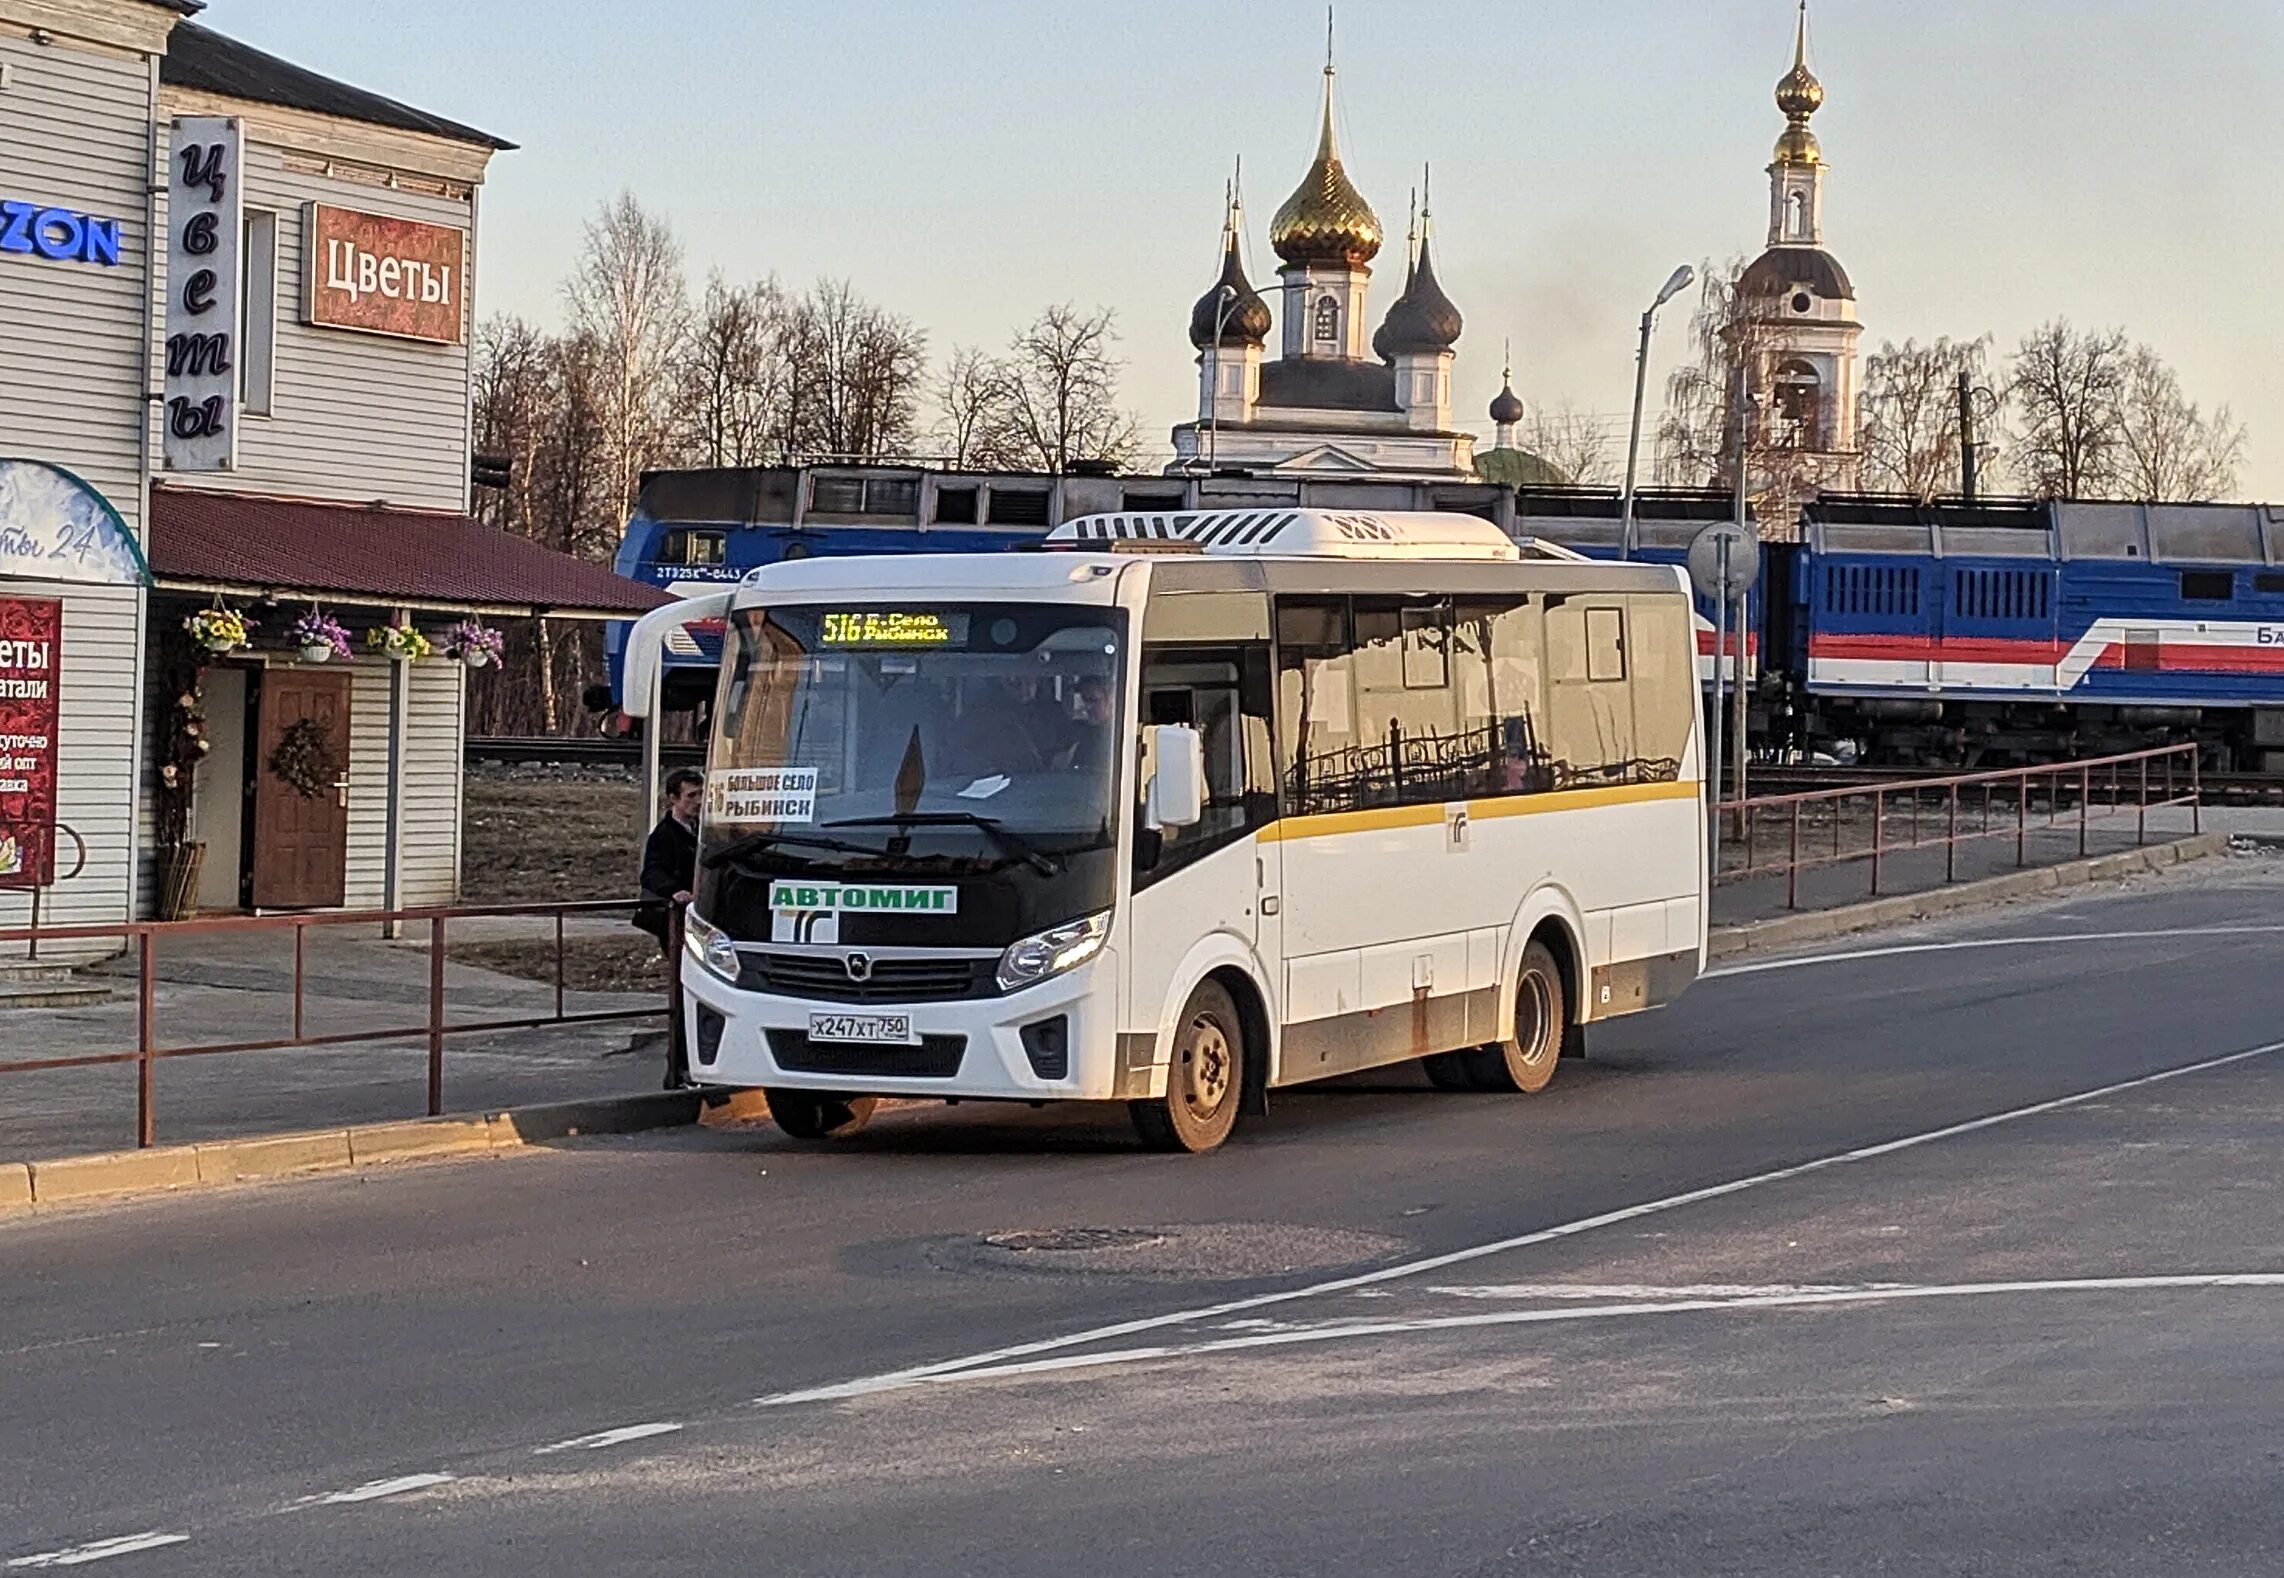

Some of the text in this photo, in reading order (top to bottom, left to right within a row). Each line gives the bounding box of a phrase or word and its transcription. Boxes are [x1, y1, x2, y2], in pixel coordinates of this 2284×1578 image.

[0, 202, 118, 265] ZON
[327, 239, 450, 305] Цветы
[48, 524, 95, 564] 24
[822, 614, 862, 641] 516
[727, 774, 815, 792] БОЛЬШОЕ СЕЛО
[725, 800, 811, 817] РЫБИНСК
[772, 887, 952, 909] АВТОМИГ
[880, 1018, 903, 1033] 750
